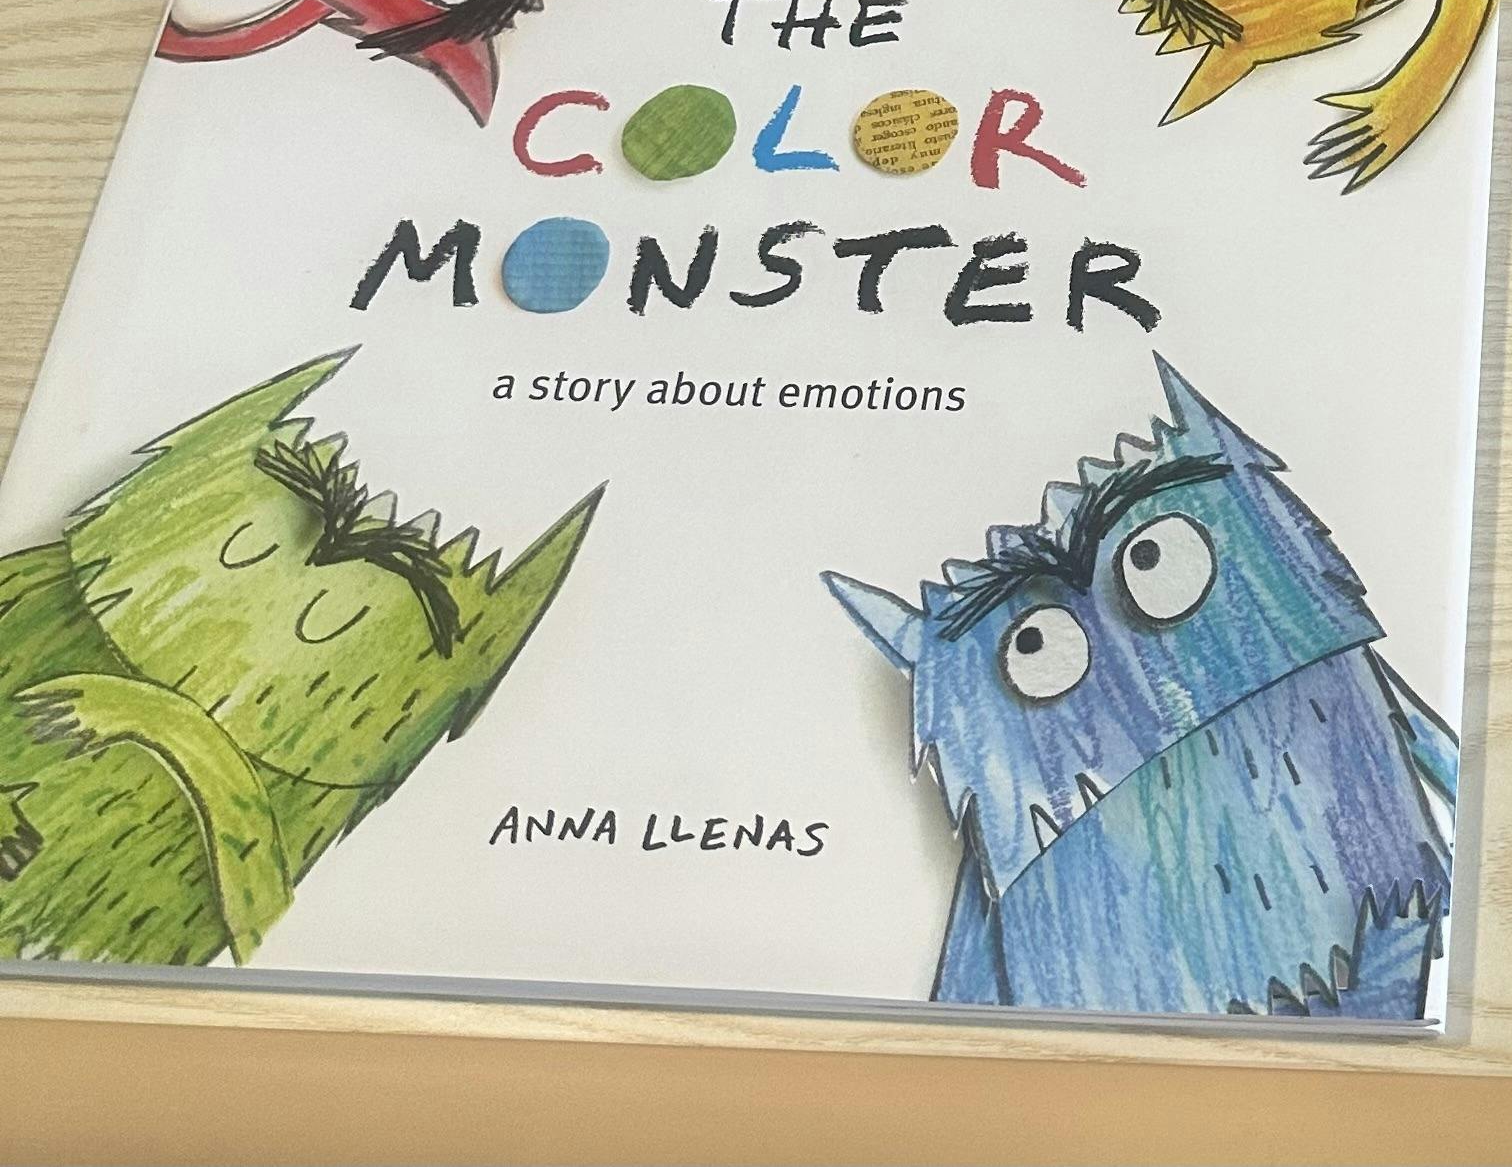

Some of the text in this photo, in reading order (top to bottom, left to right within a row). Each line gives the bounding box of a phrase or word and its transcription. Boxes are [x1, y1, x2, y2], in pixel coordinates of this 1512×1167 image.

[512, 84, 1088, 189] COLOR
[871, 128, 917, 142] escoger
[911, 148, 941, 161] muy
[350, 216, 1163, 332] MONSTER
[493, 371, 966, 412] a story about emotions
[489, 806, 830, 857] ANNA LLENAS
